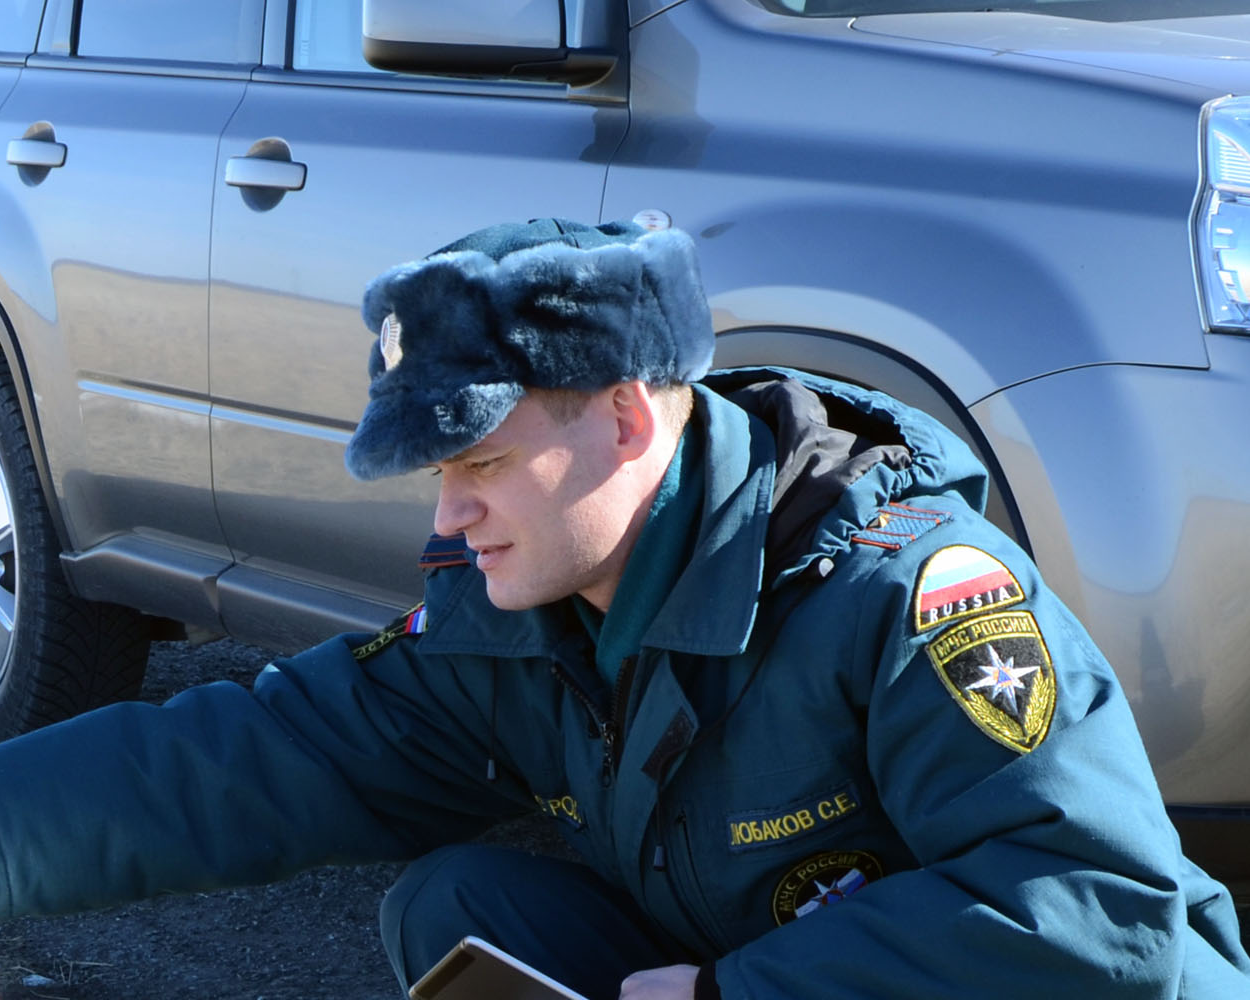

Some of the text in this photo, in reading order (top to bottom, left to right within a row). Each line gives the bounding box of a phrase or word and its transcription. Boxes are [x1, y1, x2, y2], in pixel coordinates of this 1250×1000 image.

[929, 586, 1012, 623] RUSSIA
[936, 616, 1031, 658] МЧС РОССИИ
[778, 854, 859, 912] МЧС РОССИИ
